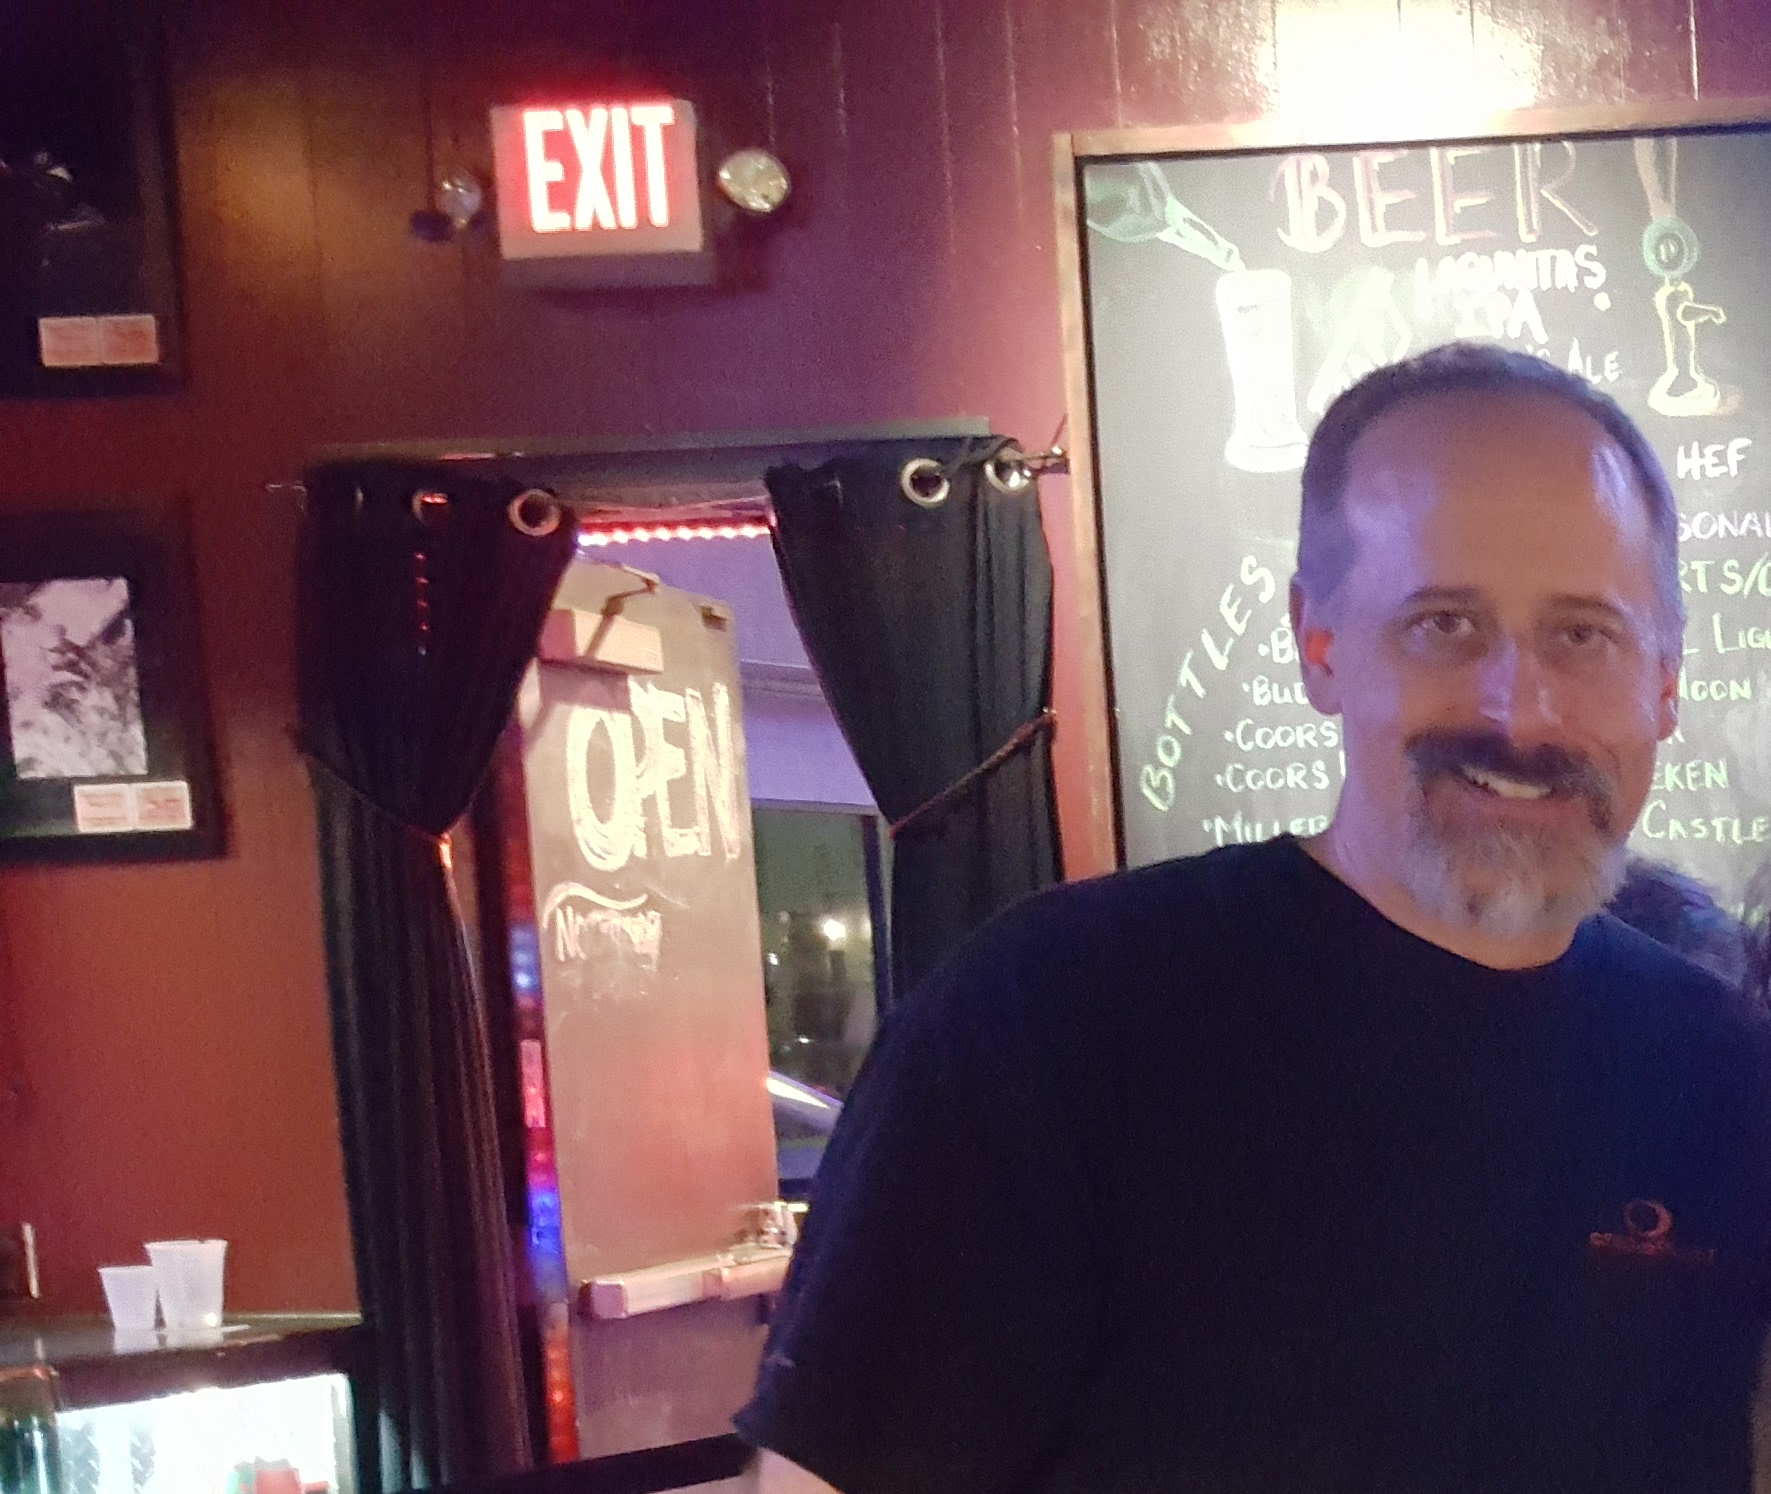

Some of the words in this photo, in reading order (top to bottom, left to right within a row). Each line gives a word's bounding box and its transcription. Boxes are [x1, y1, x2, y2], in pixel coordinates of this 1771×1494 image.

[521, 104, 675, 233] EXIT
[1271, 140, 1599, 254] BEER
[1677, 437, 1753, 480] HEF
[1140, 554, 1276, 812] BOTTLES
[1235, 718, 1340, 751] COORS
[566, 674, 741, 872] OPEN
[1225, 759, 1330, 793] COORS
